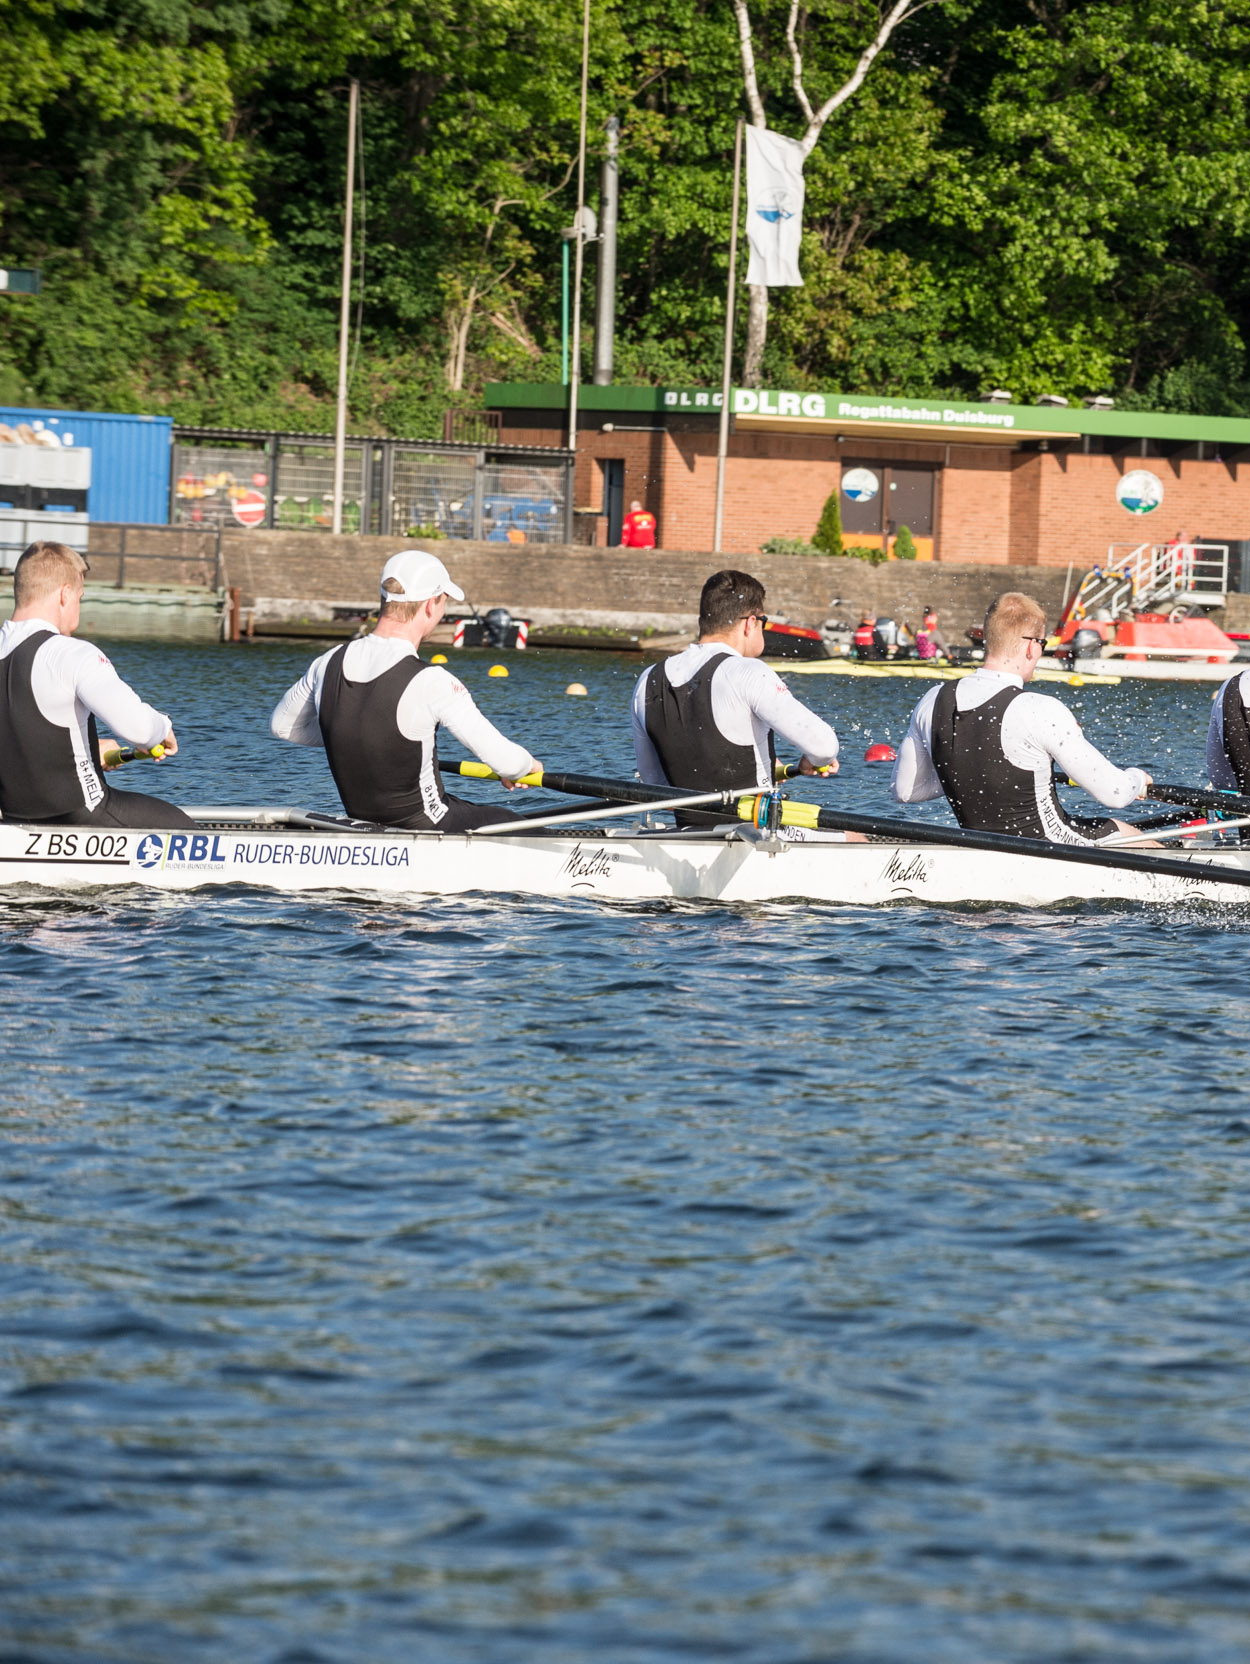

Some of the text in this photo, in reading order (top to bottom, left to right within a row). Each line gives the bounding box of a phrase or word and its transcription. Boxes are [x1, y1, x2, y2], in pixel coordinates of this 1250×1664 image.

[664, 391, 723, 407] DLRG
[735, 390, 1015, 427] DLRG Regattabahn Duisburg
[25, 833, 128, 857] Z BS 002
[167, 834, 226, 862] RBL
[233, 843, 410, 867] RUDER-BUNDESLIGA
